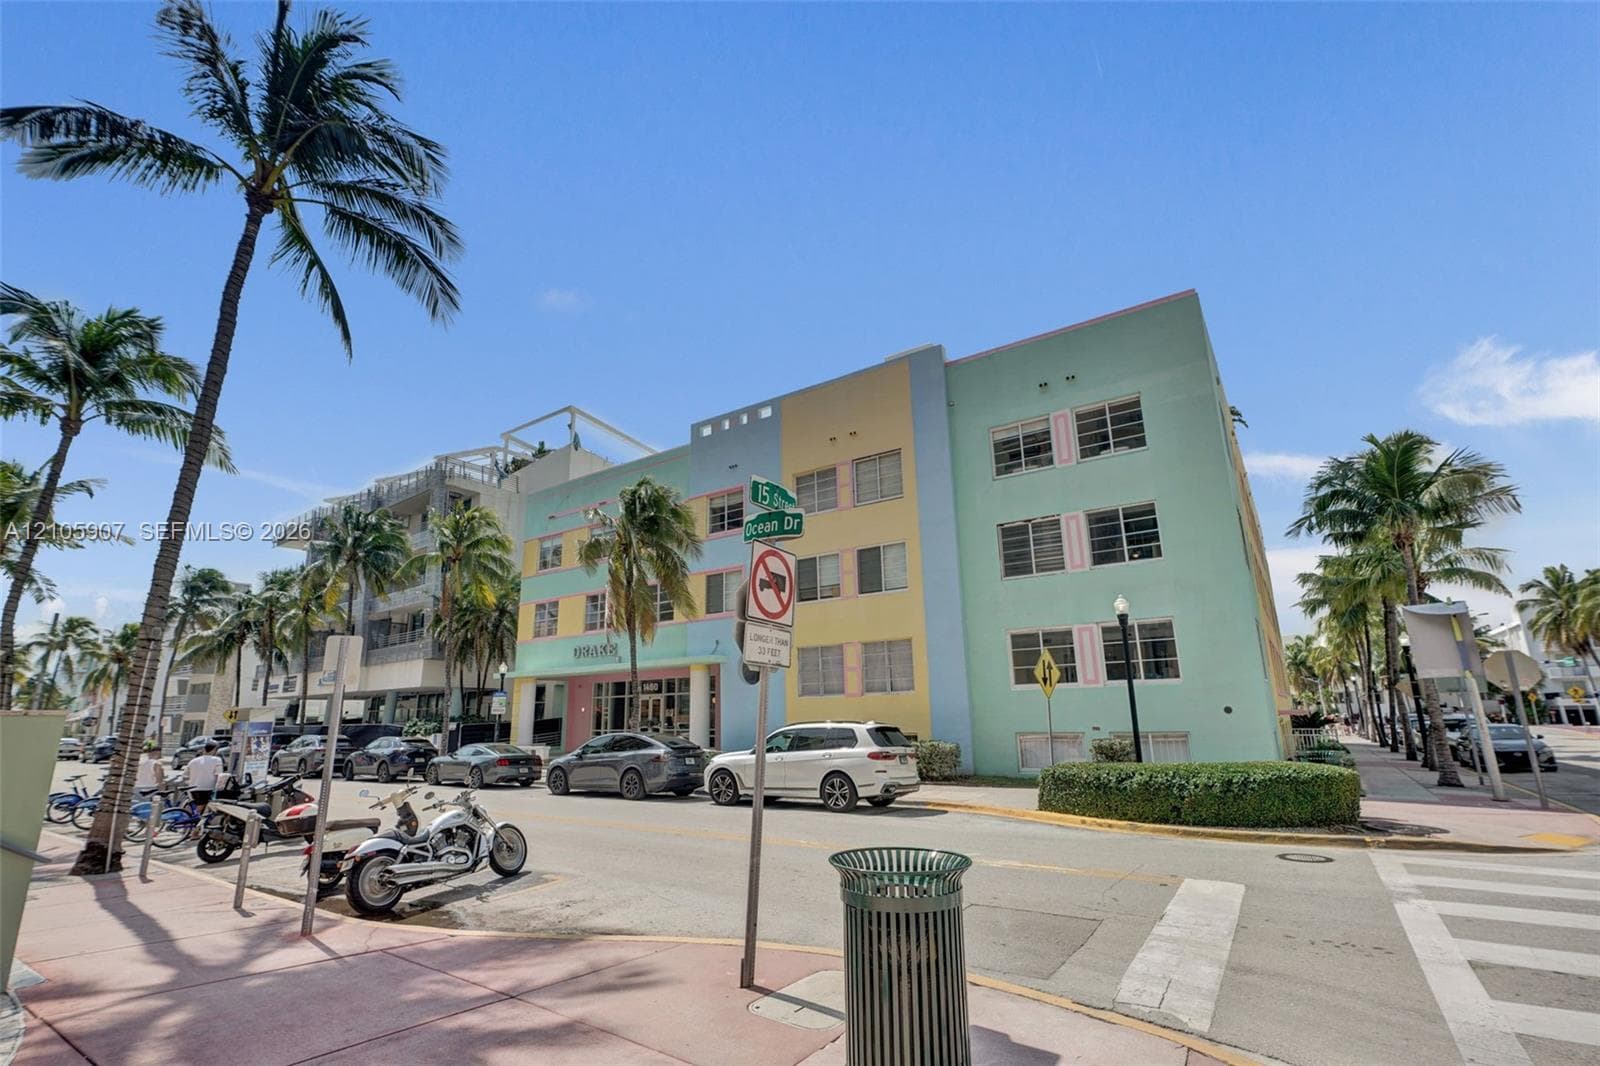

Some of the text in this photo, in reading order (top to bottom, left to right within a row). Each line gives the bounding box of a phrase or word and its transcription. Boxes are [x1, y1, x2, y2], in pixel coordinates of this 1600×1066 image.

[758, 484, 770, 505] 15
[745, 516, 801, 537] Ocean Dr
[774, 636, 789, 647] THAN
[573, 643, 619, 659] DRAKE
[767, 647, 781, 657] FEET
